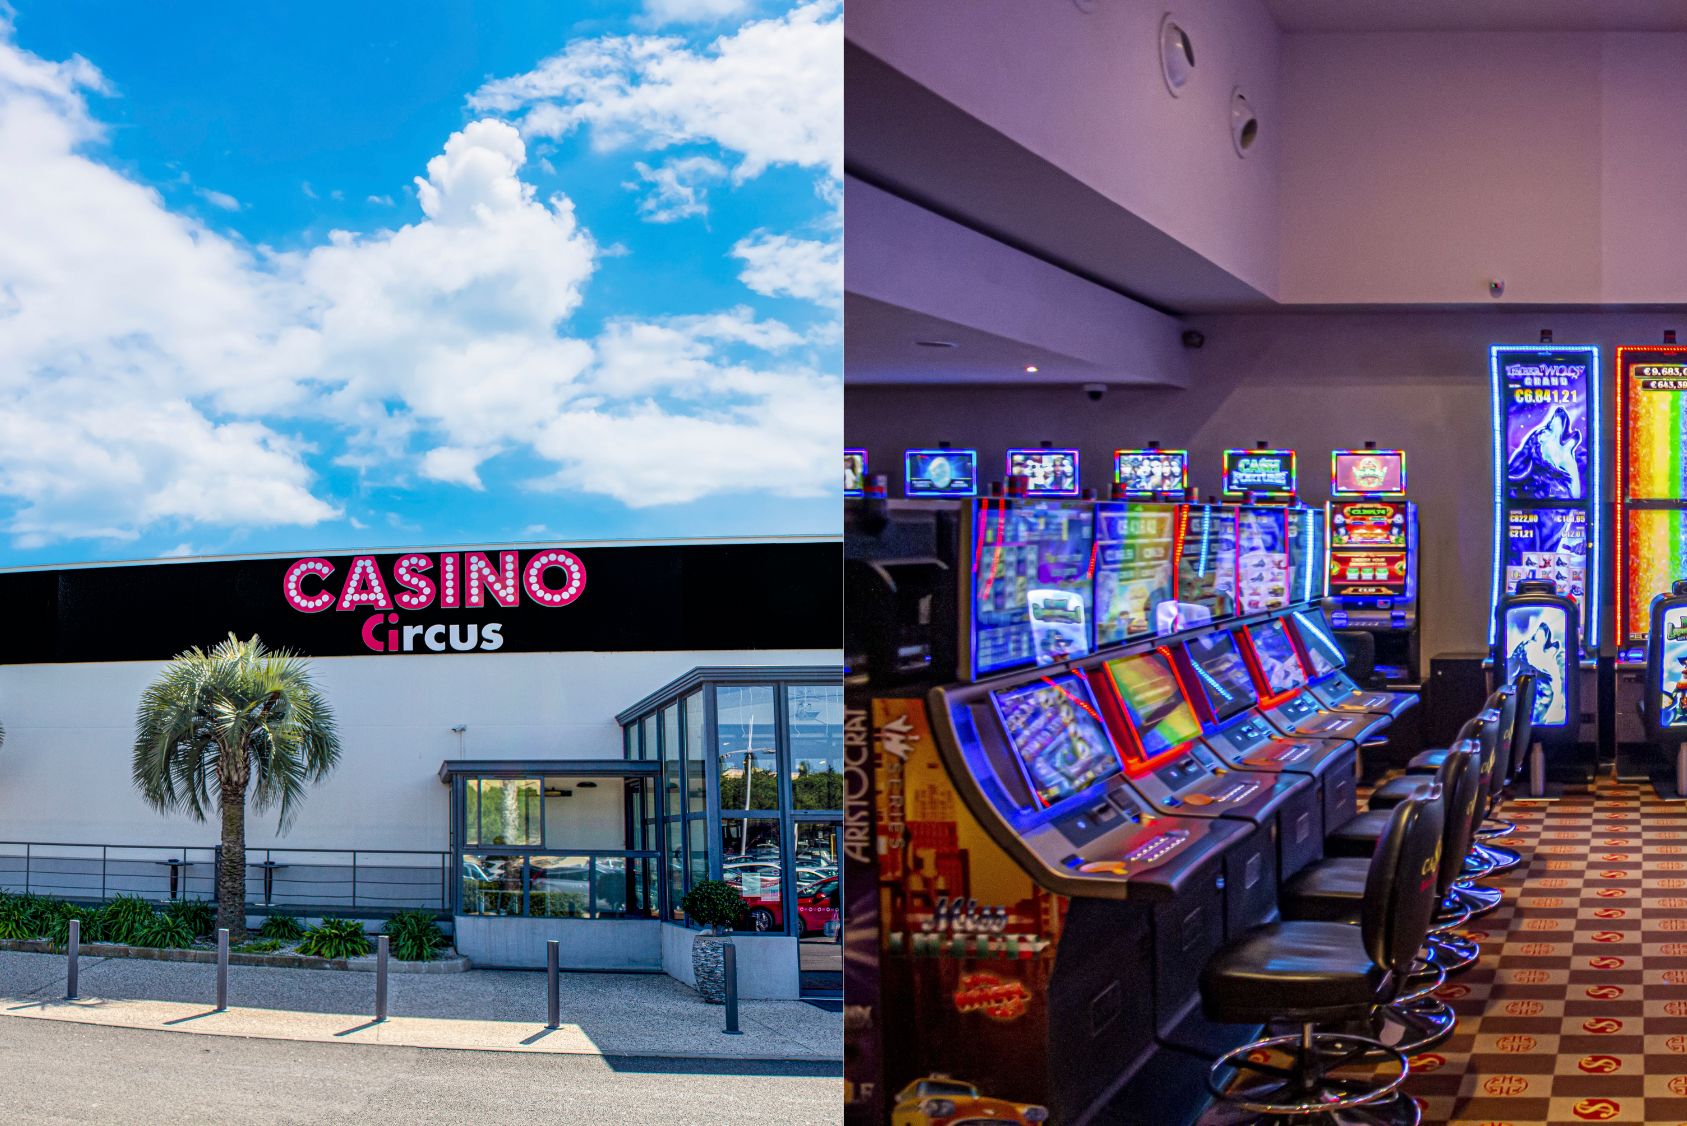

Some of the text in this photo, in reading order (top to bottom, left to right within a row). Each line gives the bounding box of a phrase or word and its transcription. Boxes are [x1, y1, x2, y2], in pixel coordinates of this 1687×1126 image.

[1524, 376, 1568, 386] GRAND
[1238, 458, 1281, 473] CASH
[284, 549, 587, 613] CASINO
[361, 612, 504, 652] Circus
[844, 705, 872, 864] ARISTOCRAT
